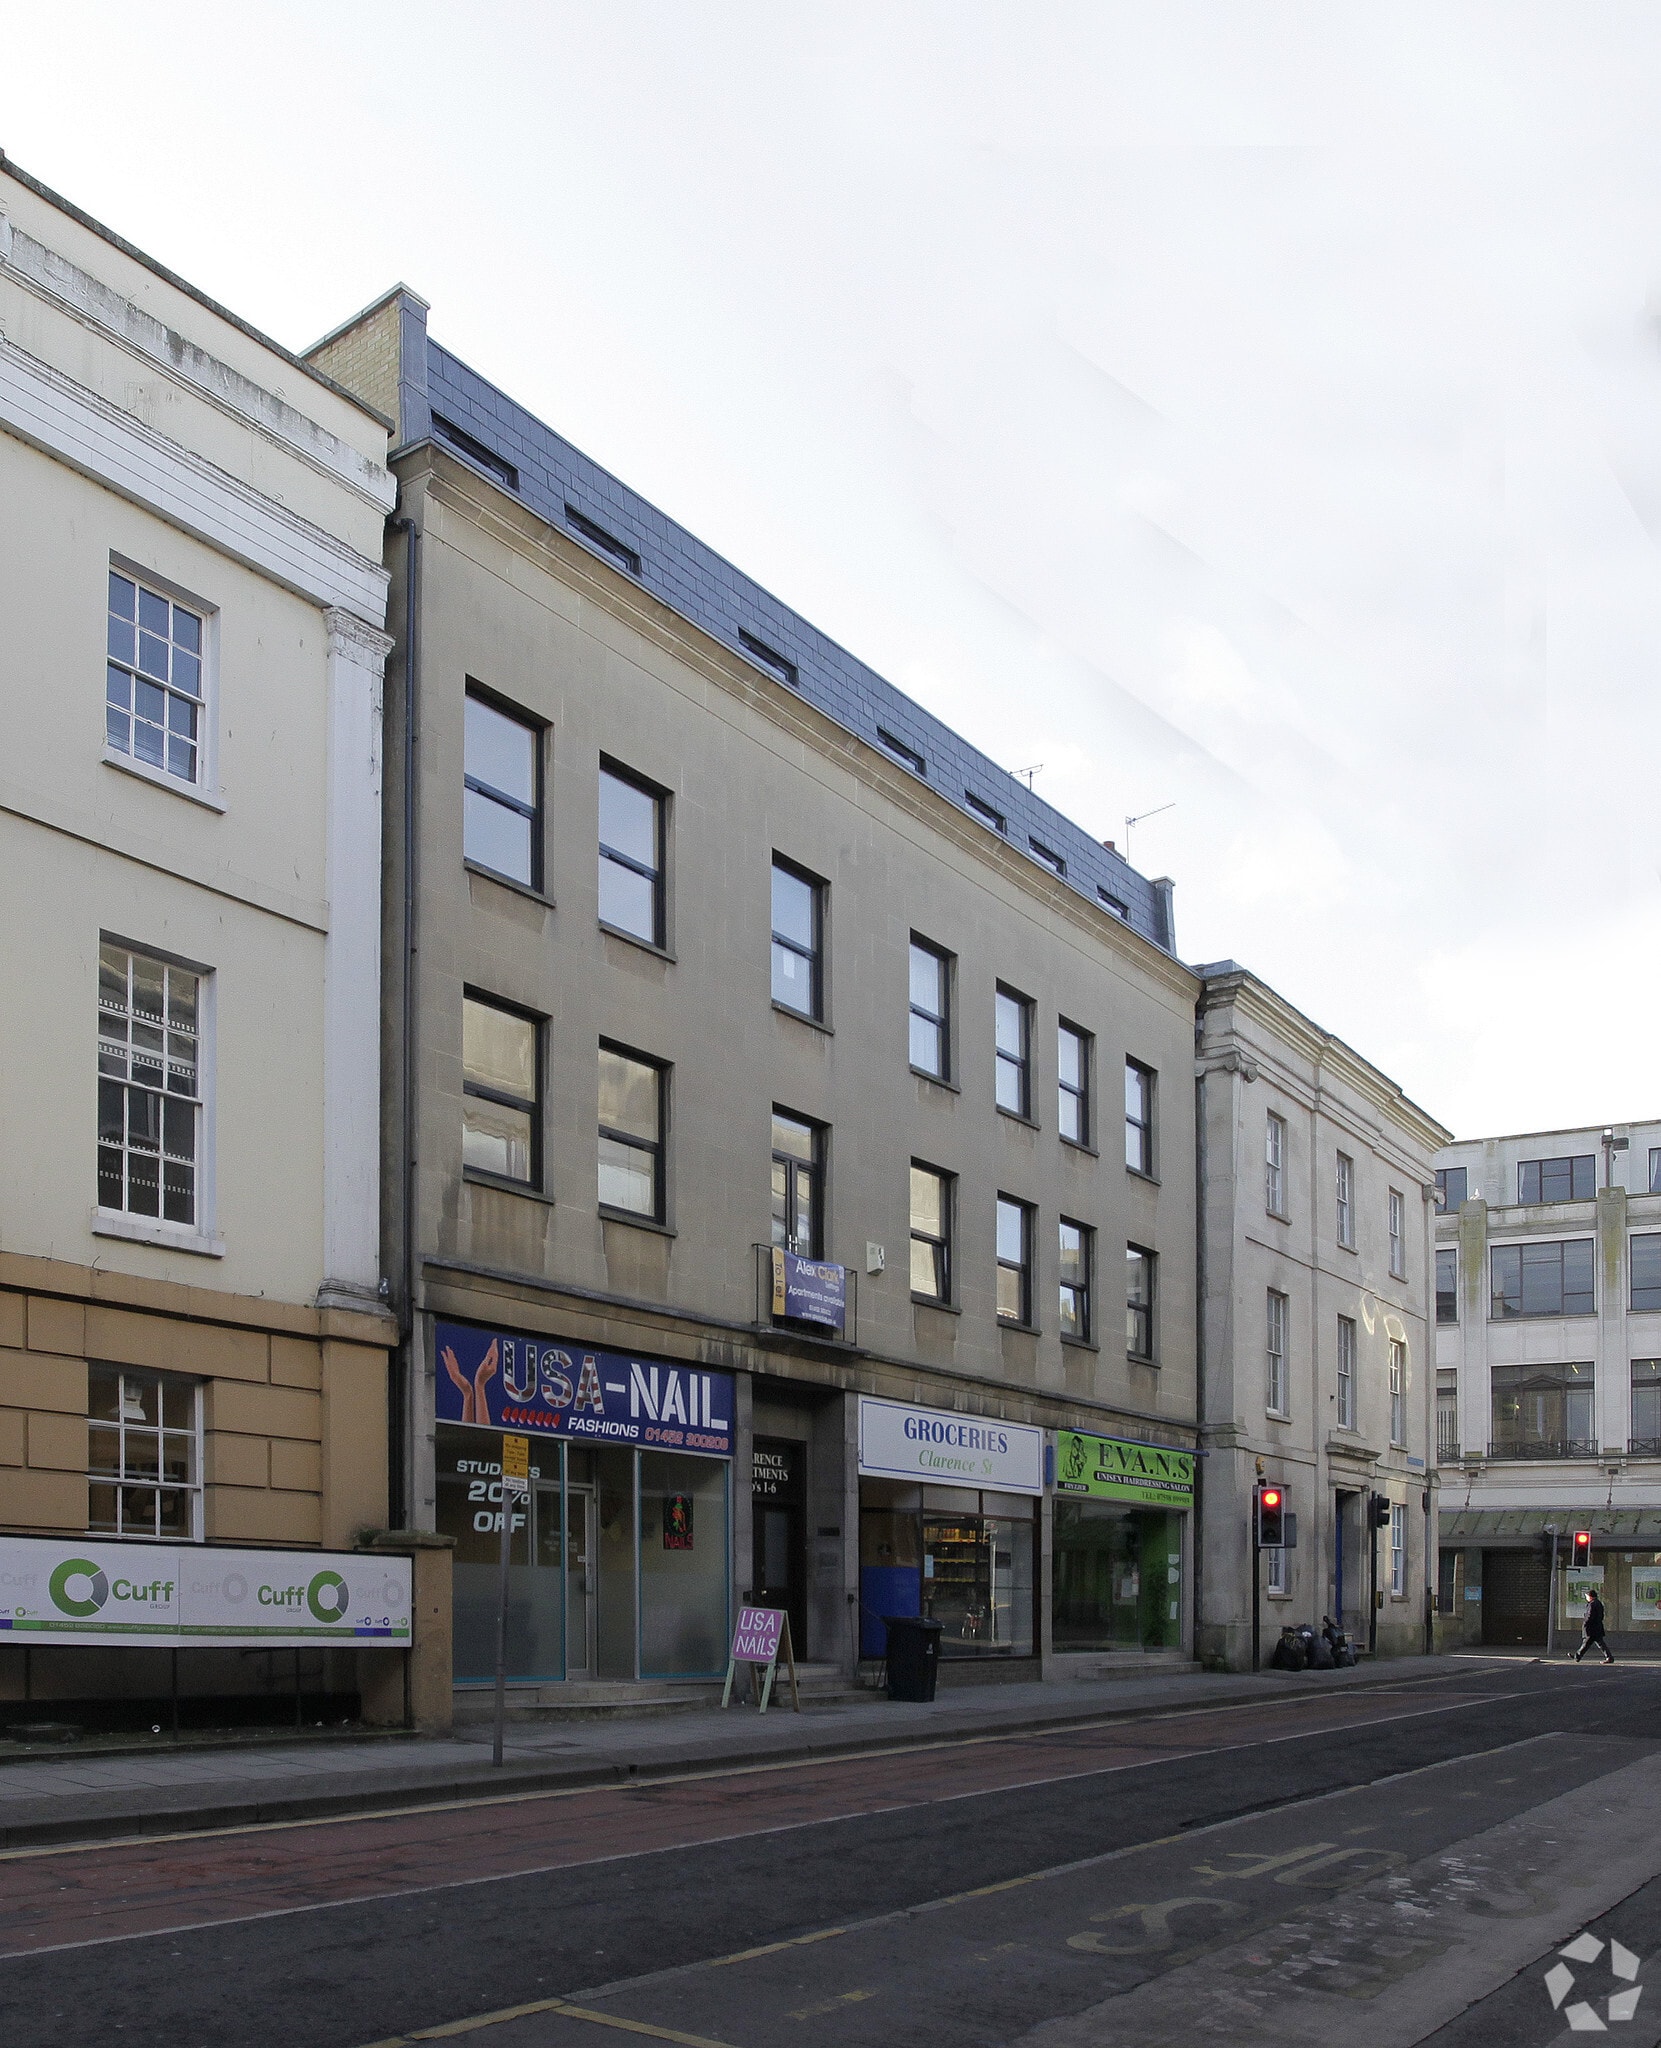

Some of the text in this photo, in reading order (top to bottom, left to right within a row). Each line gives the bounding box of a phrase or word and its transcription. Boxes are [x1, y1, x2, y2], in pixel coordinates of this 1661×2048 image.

[796, 1260, 817, 1278] Alex
[788, 1285, 823, 1301] Apartments
[503, 1340, 728, 1430] USA-NAIL
[567, 1417, 640, 1438] FASHIONS
[904, 1417, 1008, 1454] GROCERIES
[457, 1460, 541, 1479] STUDS
[752, 1452, 783, 1467] RENCE
[918, 1449, 993, 1475] Clarence St
[752, 1467, 789, 1482] TMENTS
[1097, 1472, 1190, 1492] UNISEX HAIRDRESSING SALON
[112, 1579, 175, 1602] Cuff
[258, 1585, 305, 1606] Cuff
[740, 1610, 775, 1632] USA
